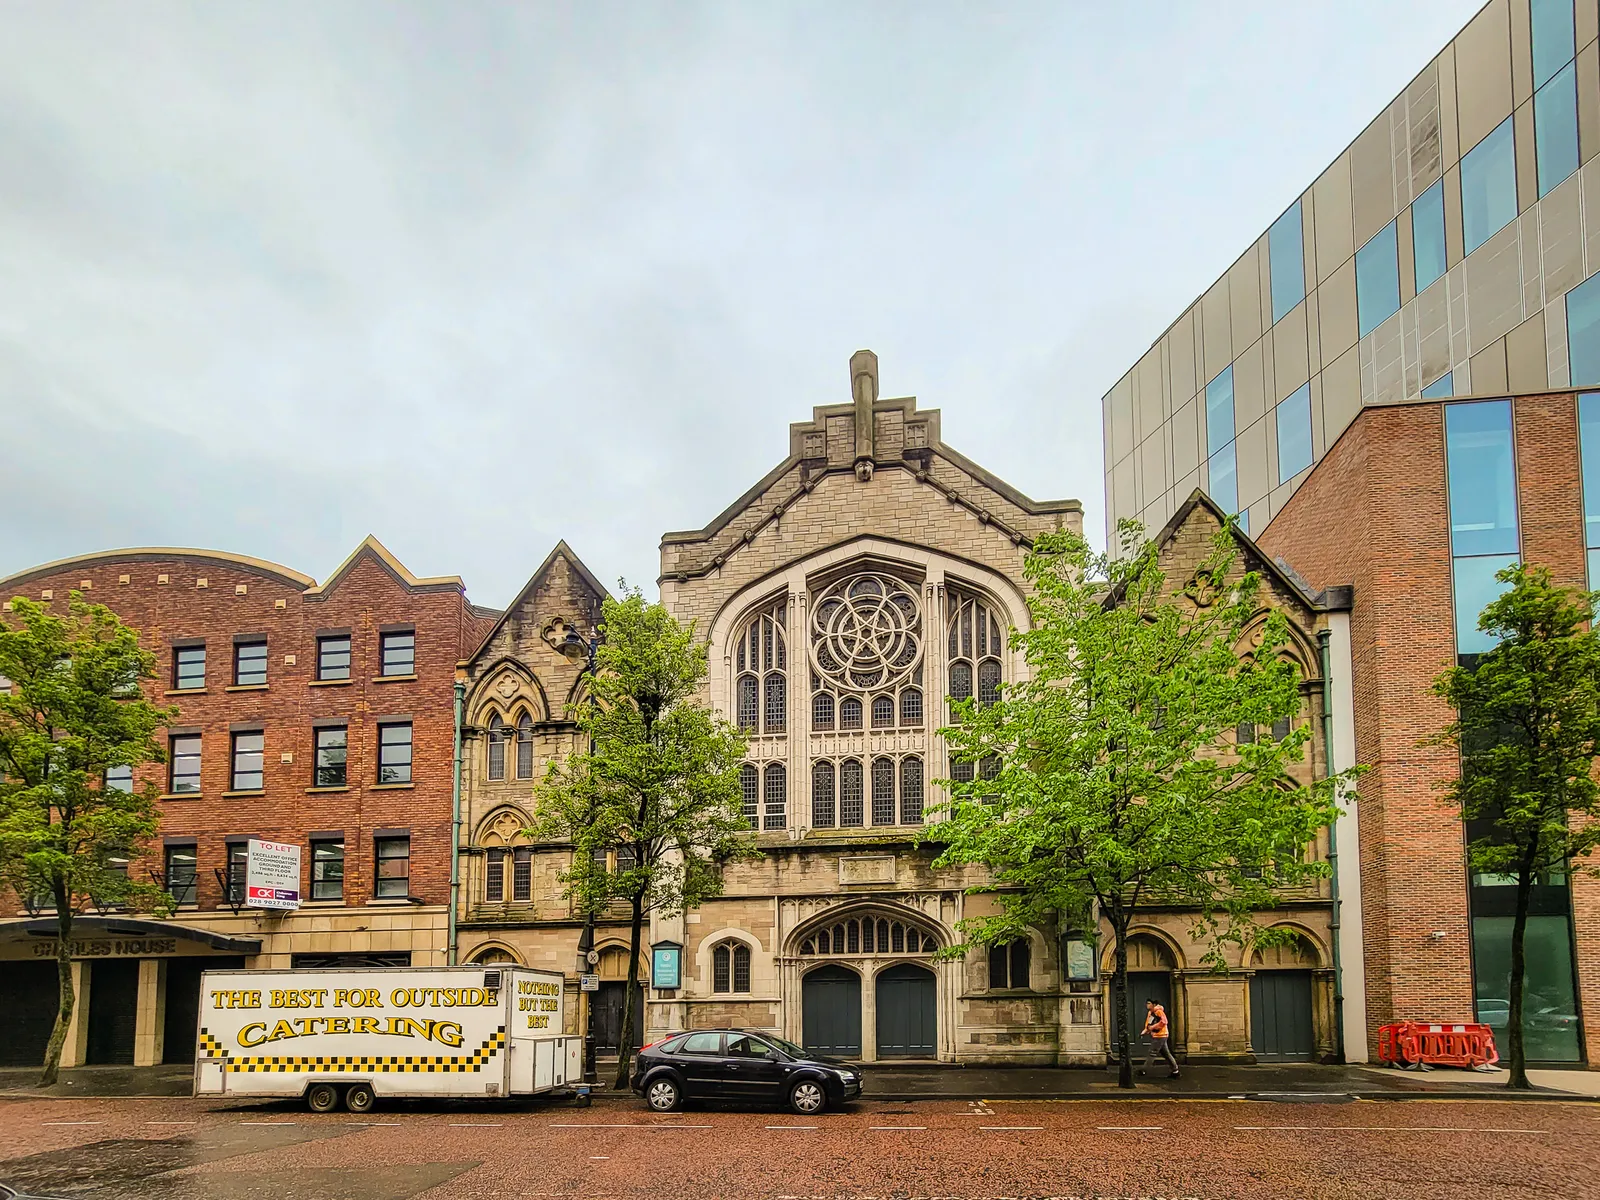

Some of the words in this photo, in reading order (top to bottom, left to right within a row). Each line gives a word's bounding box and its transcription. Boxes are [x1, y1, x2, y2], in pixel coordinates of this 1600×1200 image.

[275, 845, 292, 853] LET
[253, 857, 297, 866] ACCOMMODATION
[32, 940, 111, 957] CHRLES
[115, 939, 176, 955] HOUSE
[518, 980, 559, 996] NOTHING
[211, 989, 261, 1009] THE
[269, 989, 328, 1008] BEST
[333, 988, 384, 1008] FOR
[390, 987, 499, 1007] OUTSIDE
[519, 997, 538, 1011] BUT
[540, 998, 558, 1012] THE
[527, 1015, 549, 1028] BEST
[237, 1016, 465, 1049] CATERING
